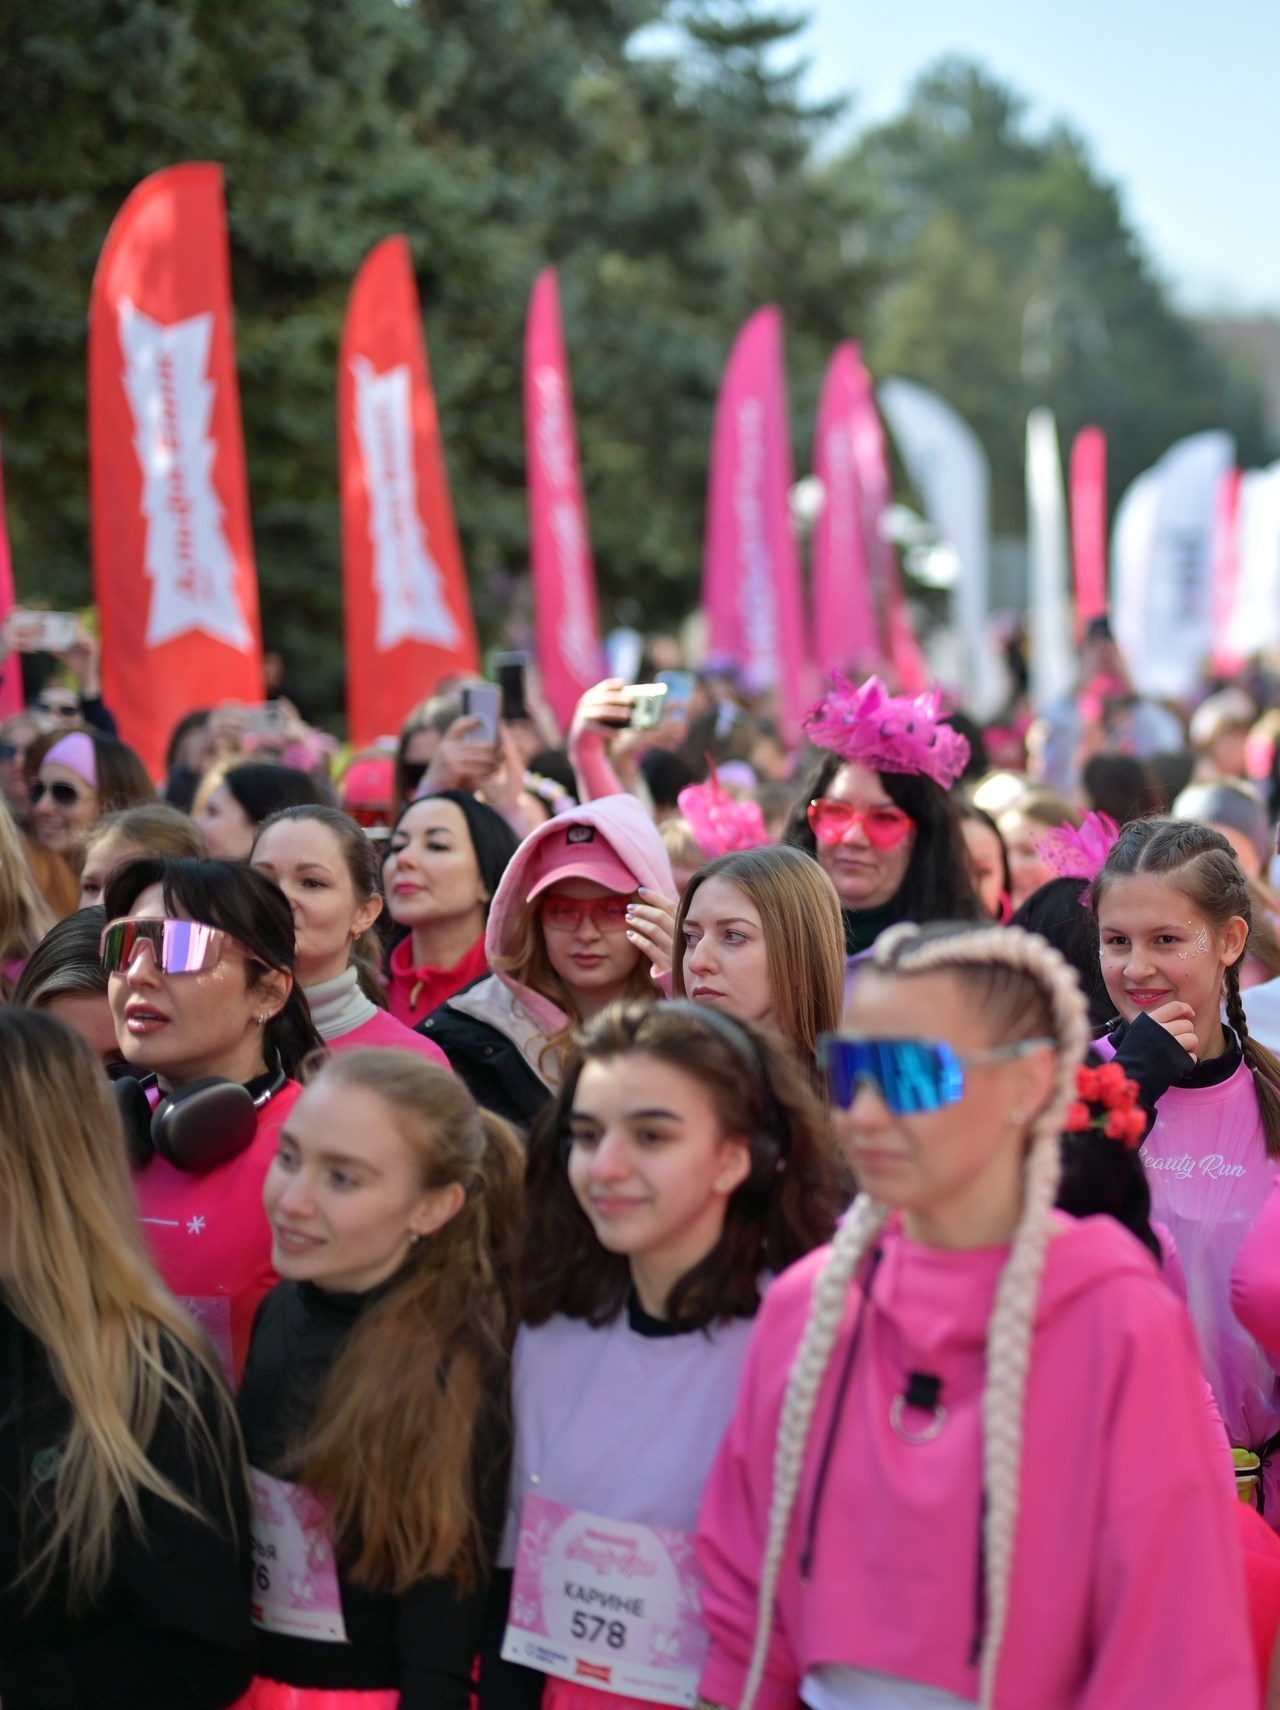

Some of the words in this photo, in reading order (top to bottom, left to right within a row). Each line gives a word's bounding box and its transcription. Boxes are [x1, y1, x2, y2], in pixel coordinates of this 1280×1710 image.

[1199, 1154, 1247, 1180] Run
[563, 1580, 645, 1619] КАРИНЕ
[569, 1610, 627, 1650] 578
